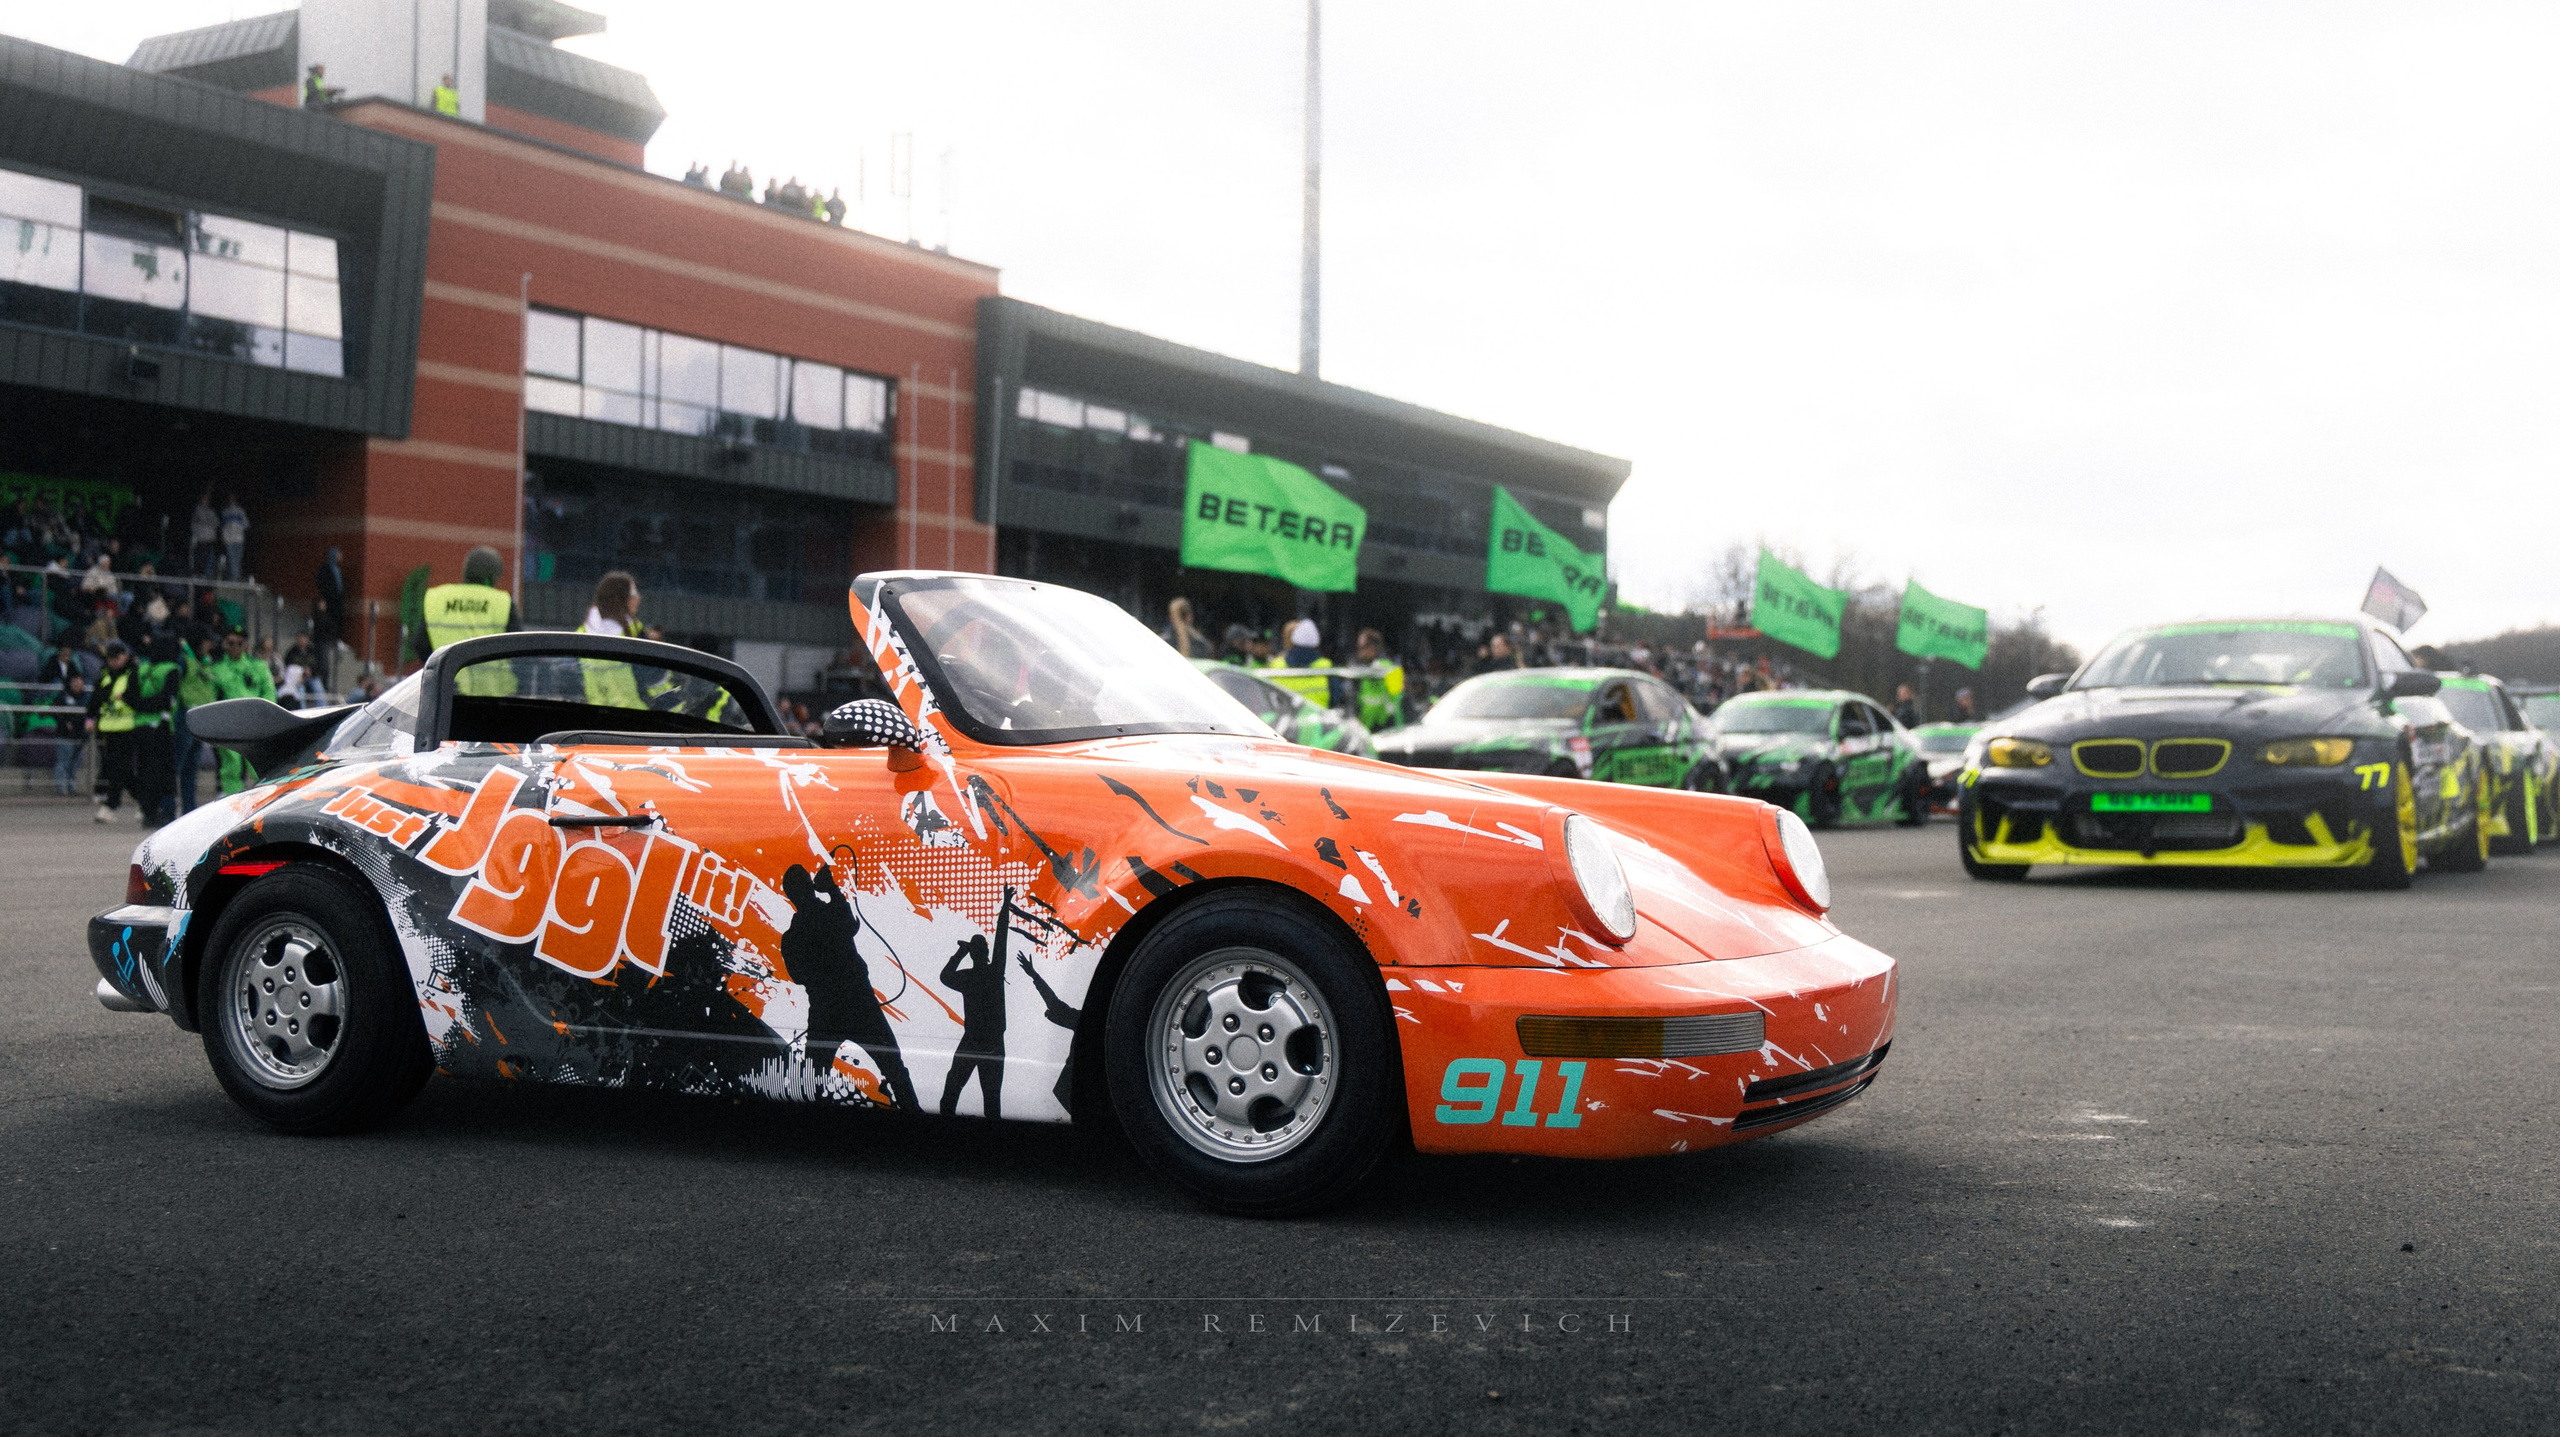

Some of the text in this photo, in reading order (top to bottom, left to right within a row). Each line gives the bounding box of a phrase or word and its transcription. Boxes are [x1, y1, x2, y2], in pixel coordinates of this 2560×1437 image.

[1199, 493, 1354, 549] BETERA
[2354, 762, 2389, 791] 77
[320, 785, 431, 850] Just
[689, 852, 757, 927] it!
[1435, 1058, 1587, 1128] 911
